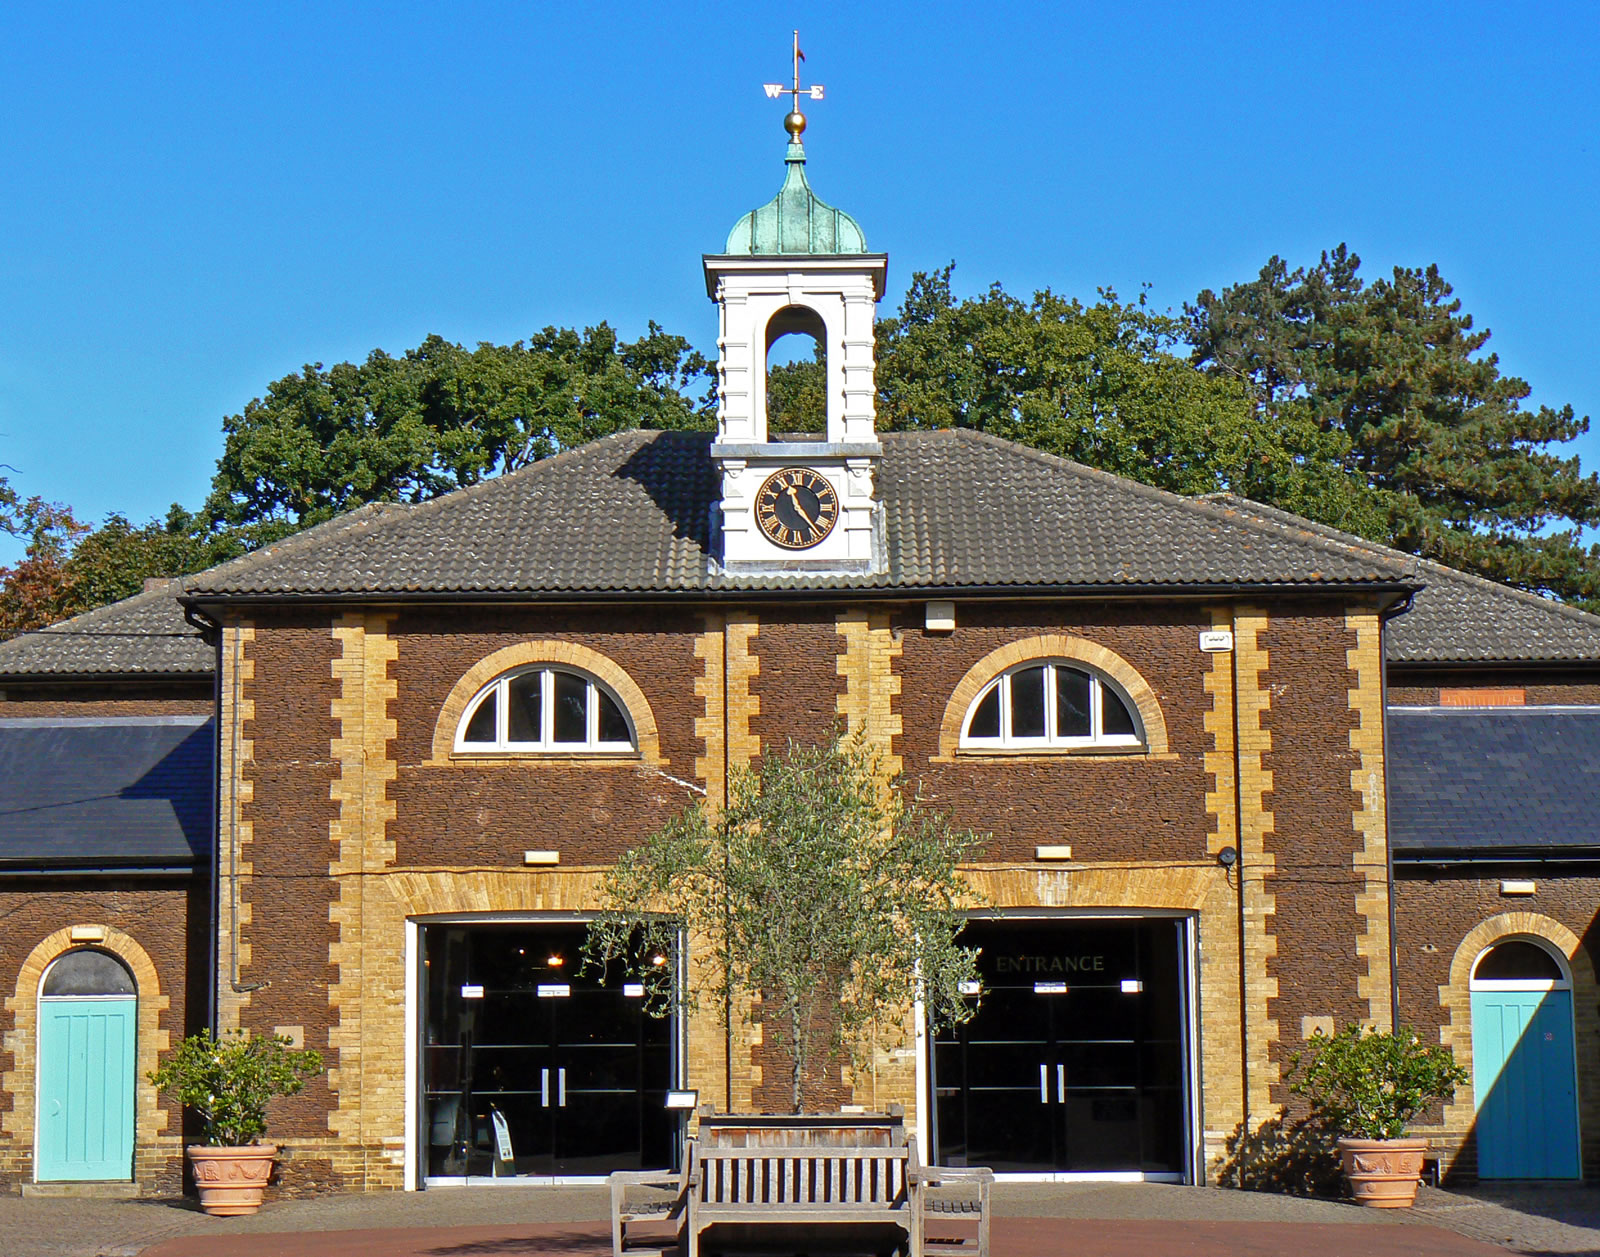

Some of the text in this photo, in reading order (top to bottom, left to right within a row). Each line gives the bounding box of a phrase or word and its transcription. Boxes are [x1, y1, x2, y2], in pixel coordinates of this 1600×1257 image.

[763, 84, 783, 98] W
[810, 85, 824, 99] E
[791, 473, 804, 486] XII
[820, 503, 833, 512] III
[996, 955, 1105, 972] ENTRANCE
